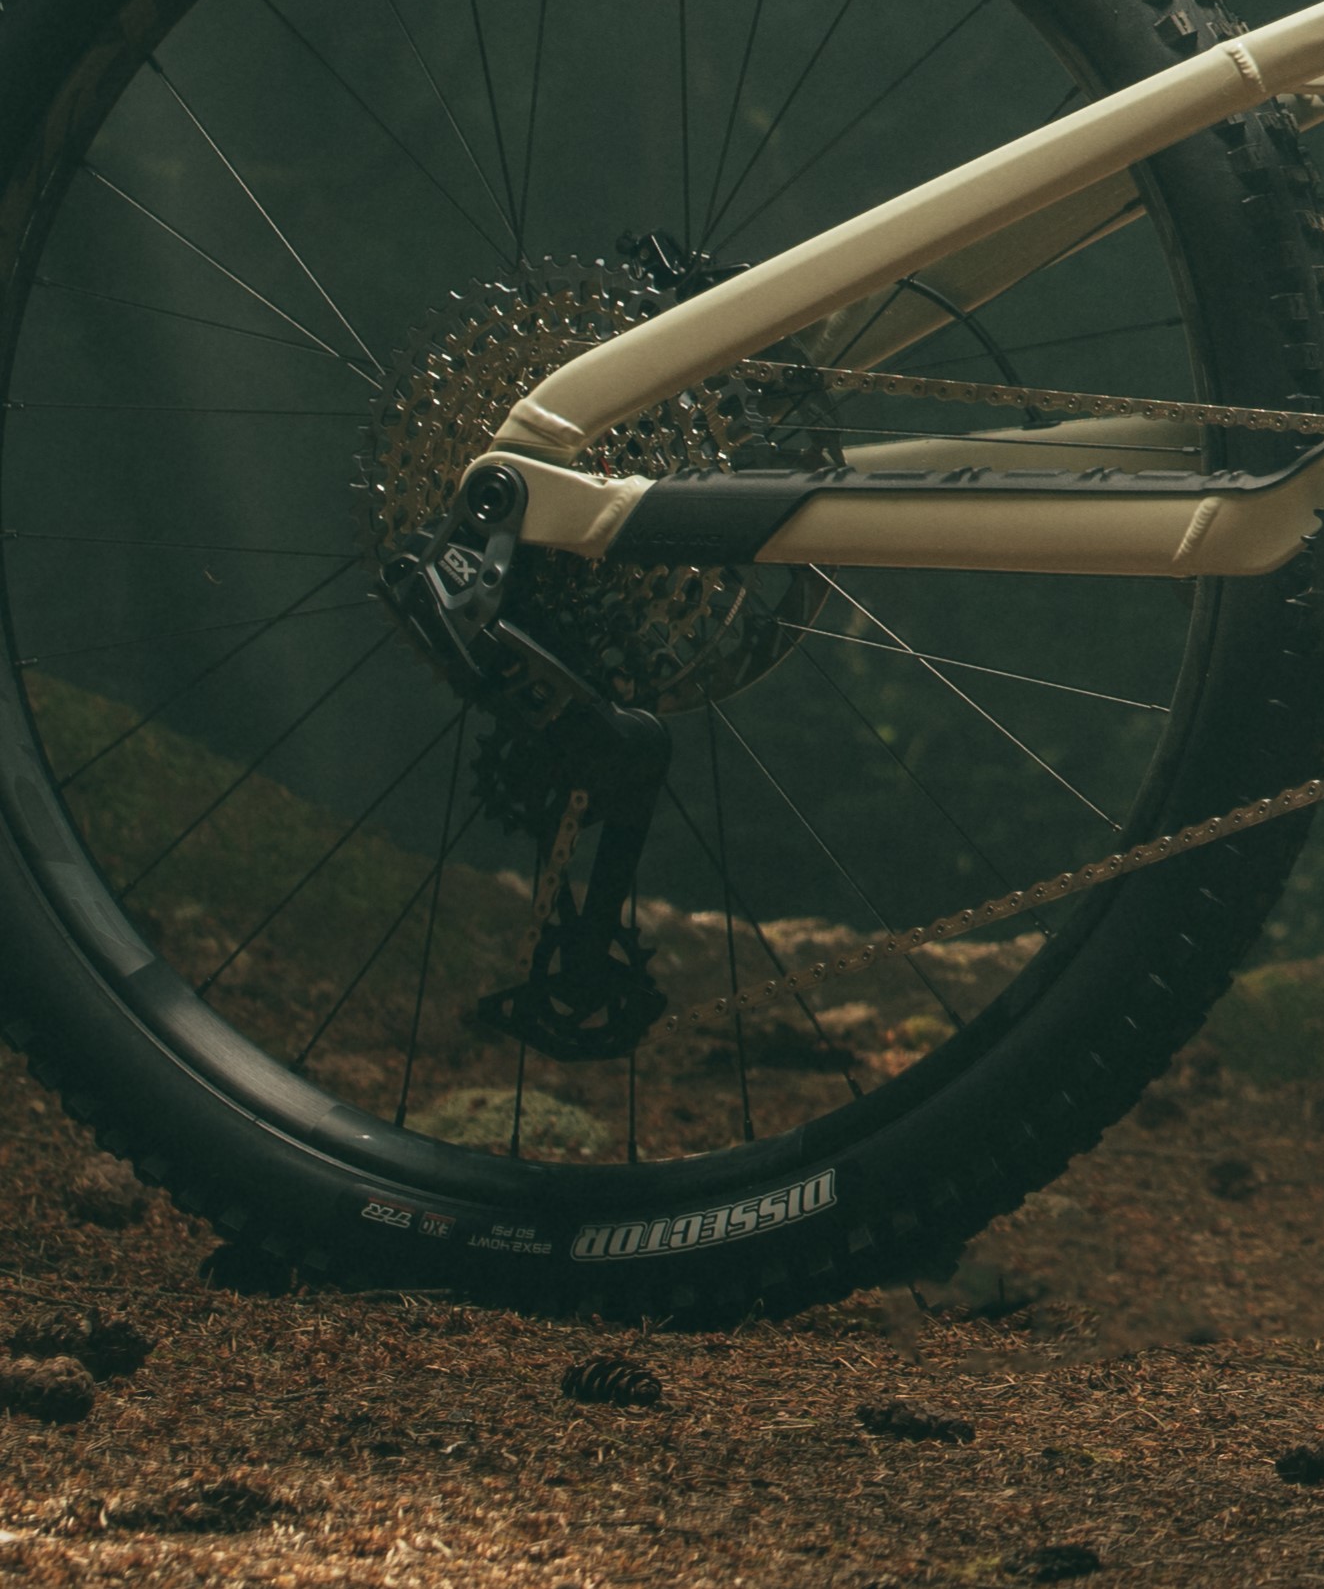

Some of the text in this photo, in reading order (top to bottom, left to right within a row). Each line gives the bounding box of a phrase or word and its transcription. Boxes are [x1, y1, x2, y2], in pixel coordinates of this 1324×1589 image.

[443, 547, 478, 583] GX
[361, 1202, 412, 1229] TR
[421, 1217, 450, 1237] EXO
[571, 1168, 837, 1261] DISSECTOR
[490, 1224, 536, 1239] 50 PSI
